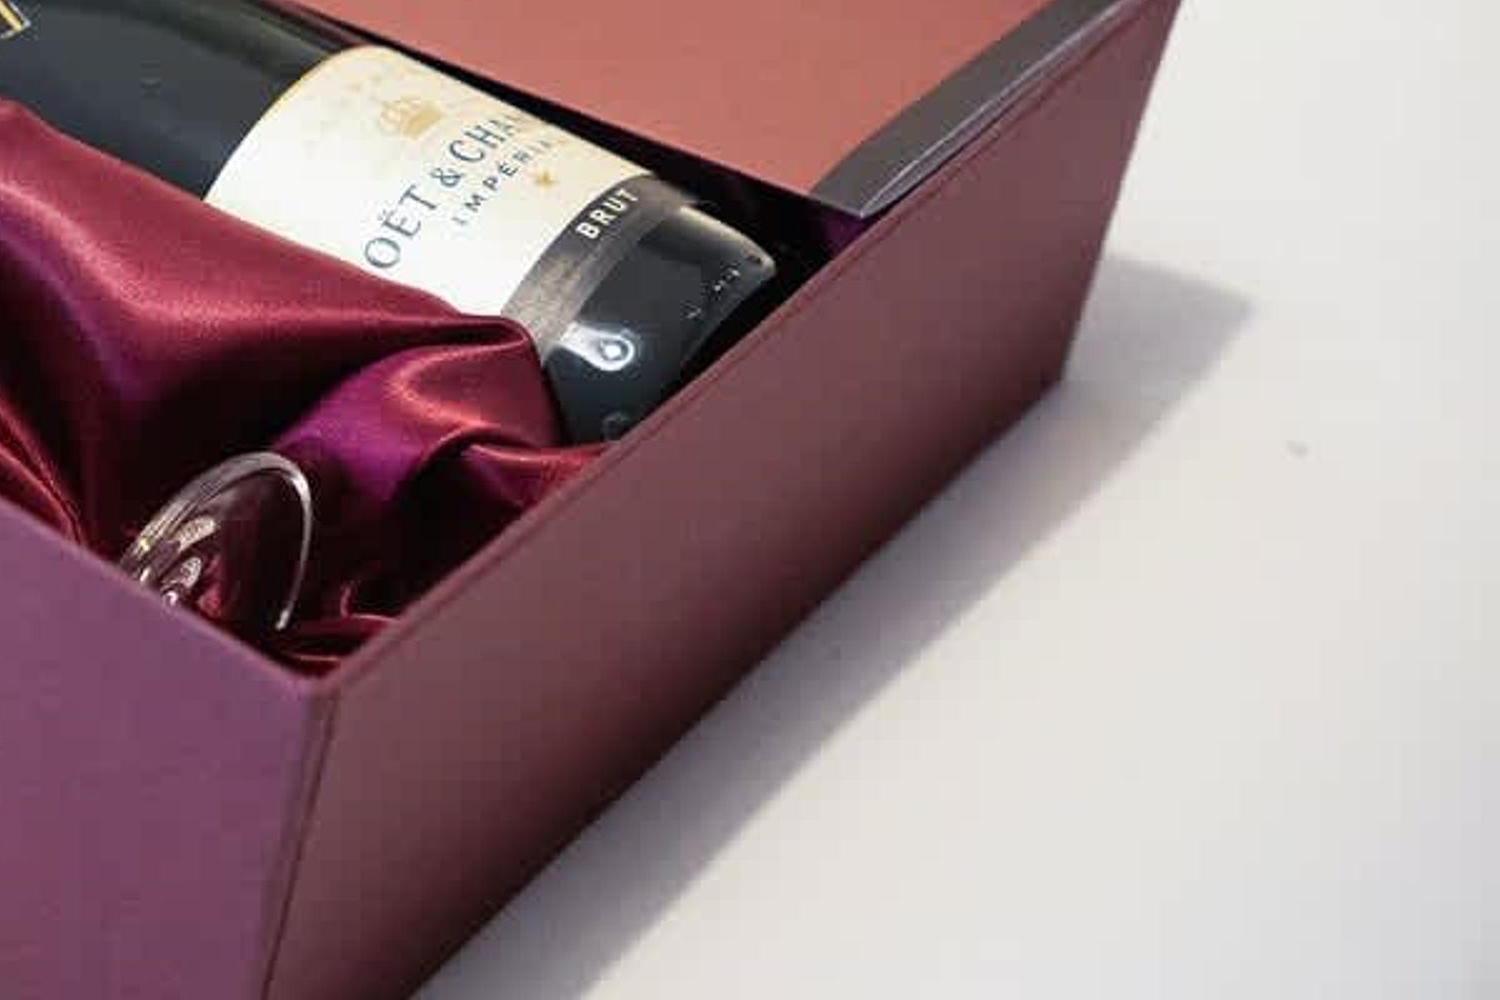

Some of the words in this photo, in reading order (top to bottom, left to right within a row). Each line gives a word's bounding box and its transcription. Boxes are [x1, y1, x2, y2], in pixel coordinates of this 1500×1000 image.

[363, 184, 437, 270] OËT
[430, 167, 465, 189] &
[575, 186, 639, 239] BRUT
